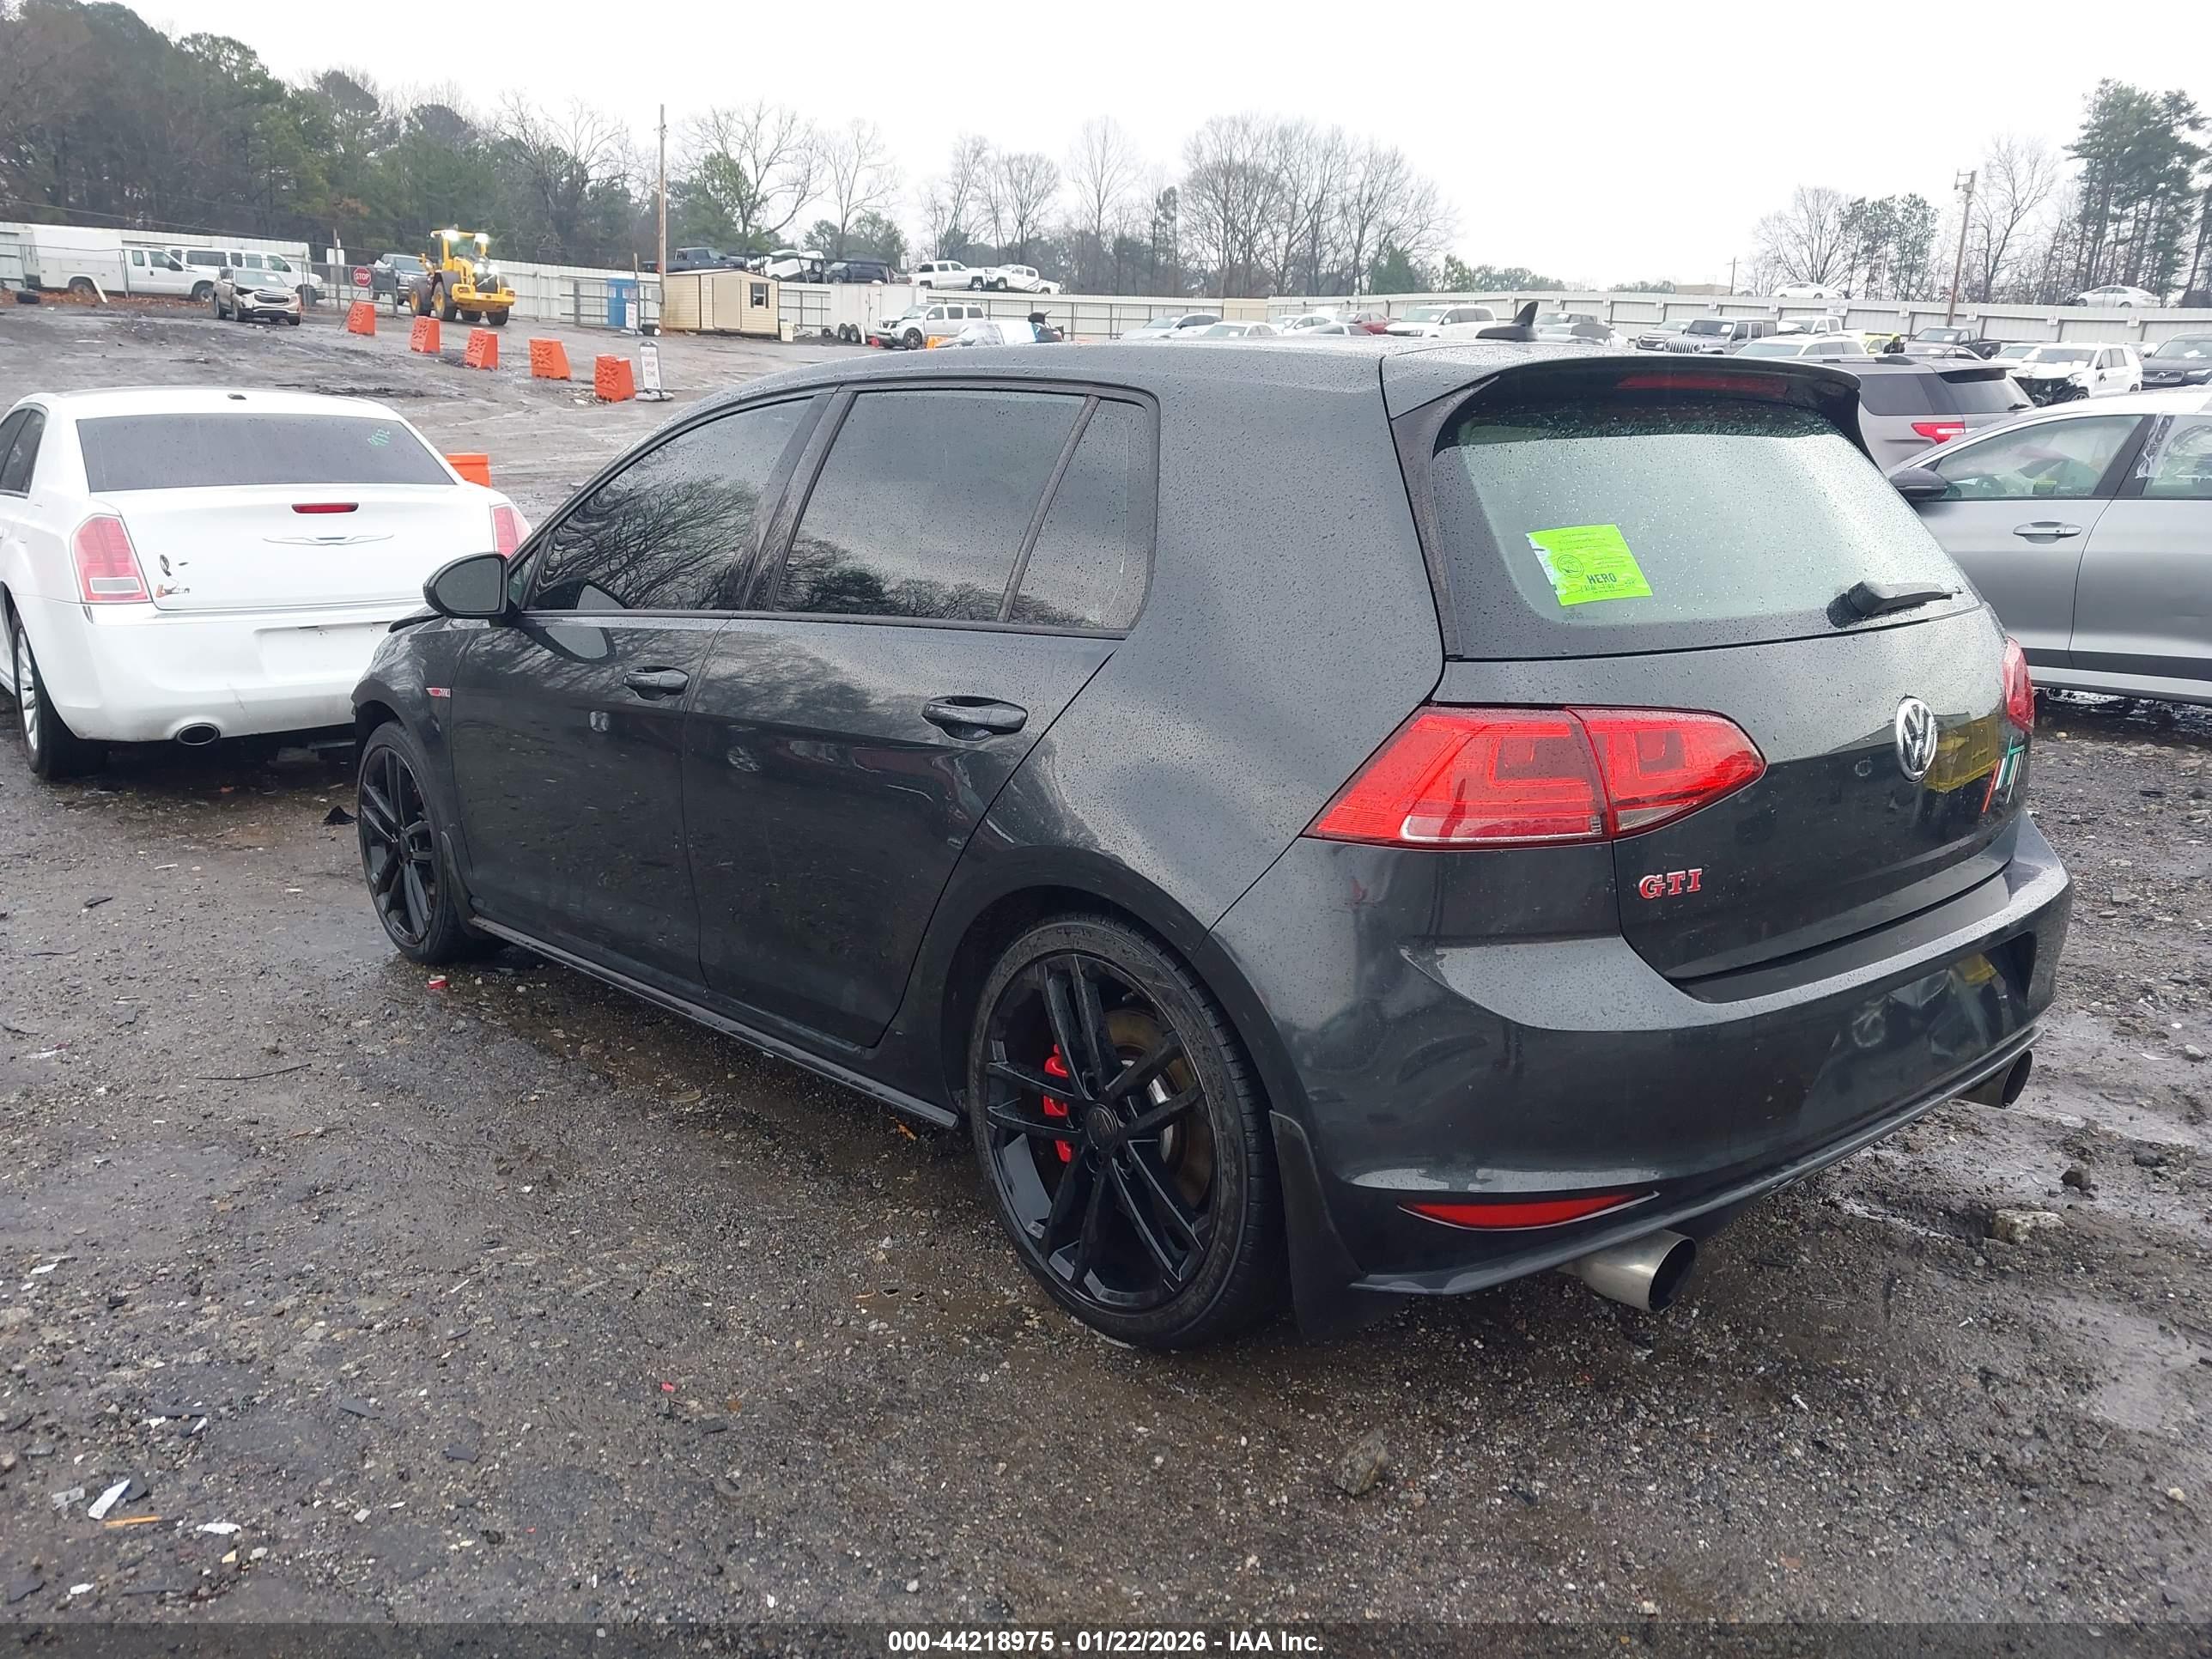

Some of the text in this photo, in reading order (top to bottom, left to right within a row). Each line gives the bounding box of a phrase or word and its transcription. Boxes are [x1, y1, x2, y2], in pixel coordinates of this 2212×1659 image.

[355, 272, 370, 281] STOP
[1587, 573, 1618, 585] HERO
[1638, 867, 1704, 900] GTI
